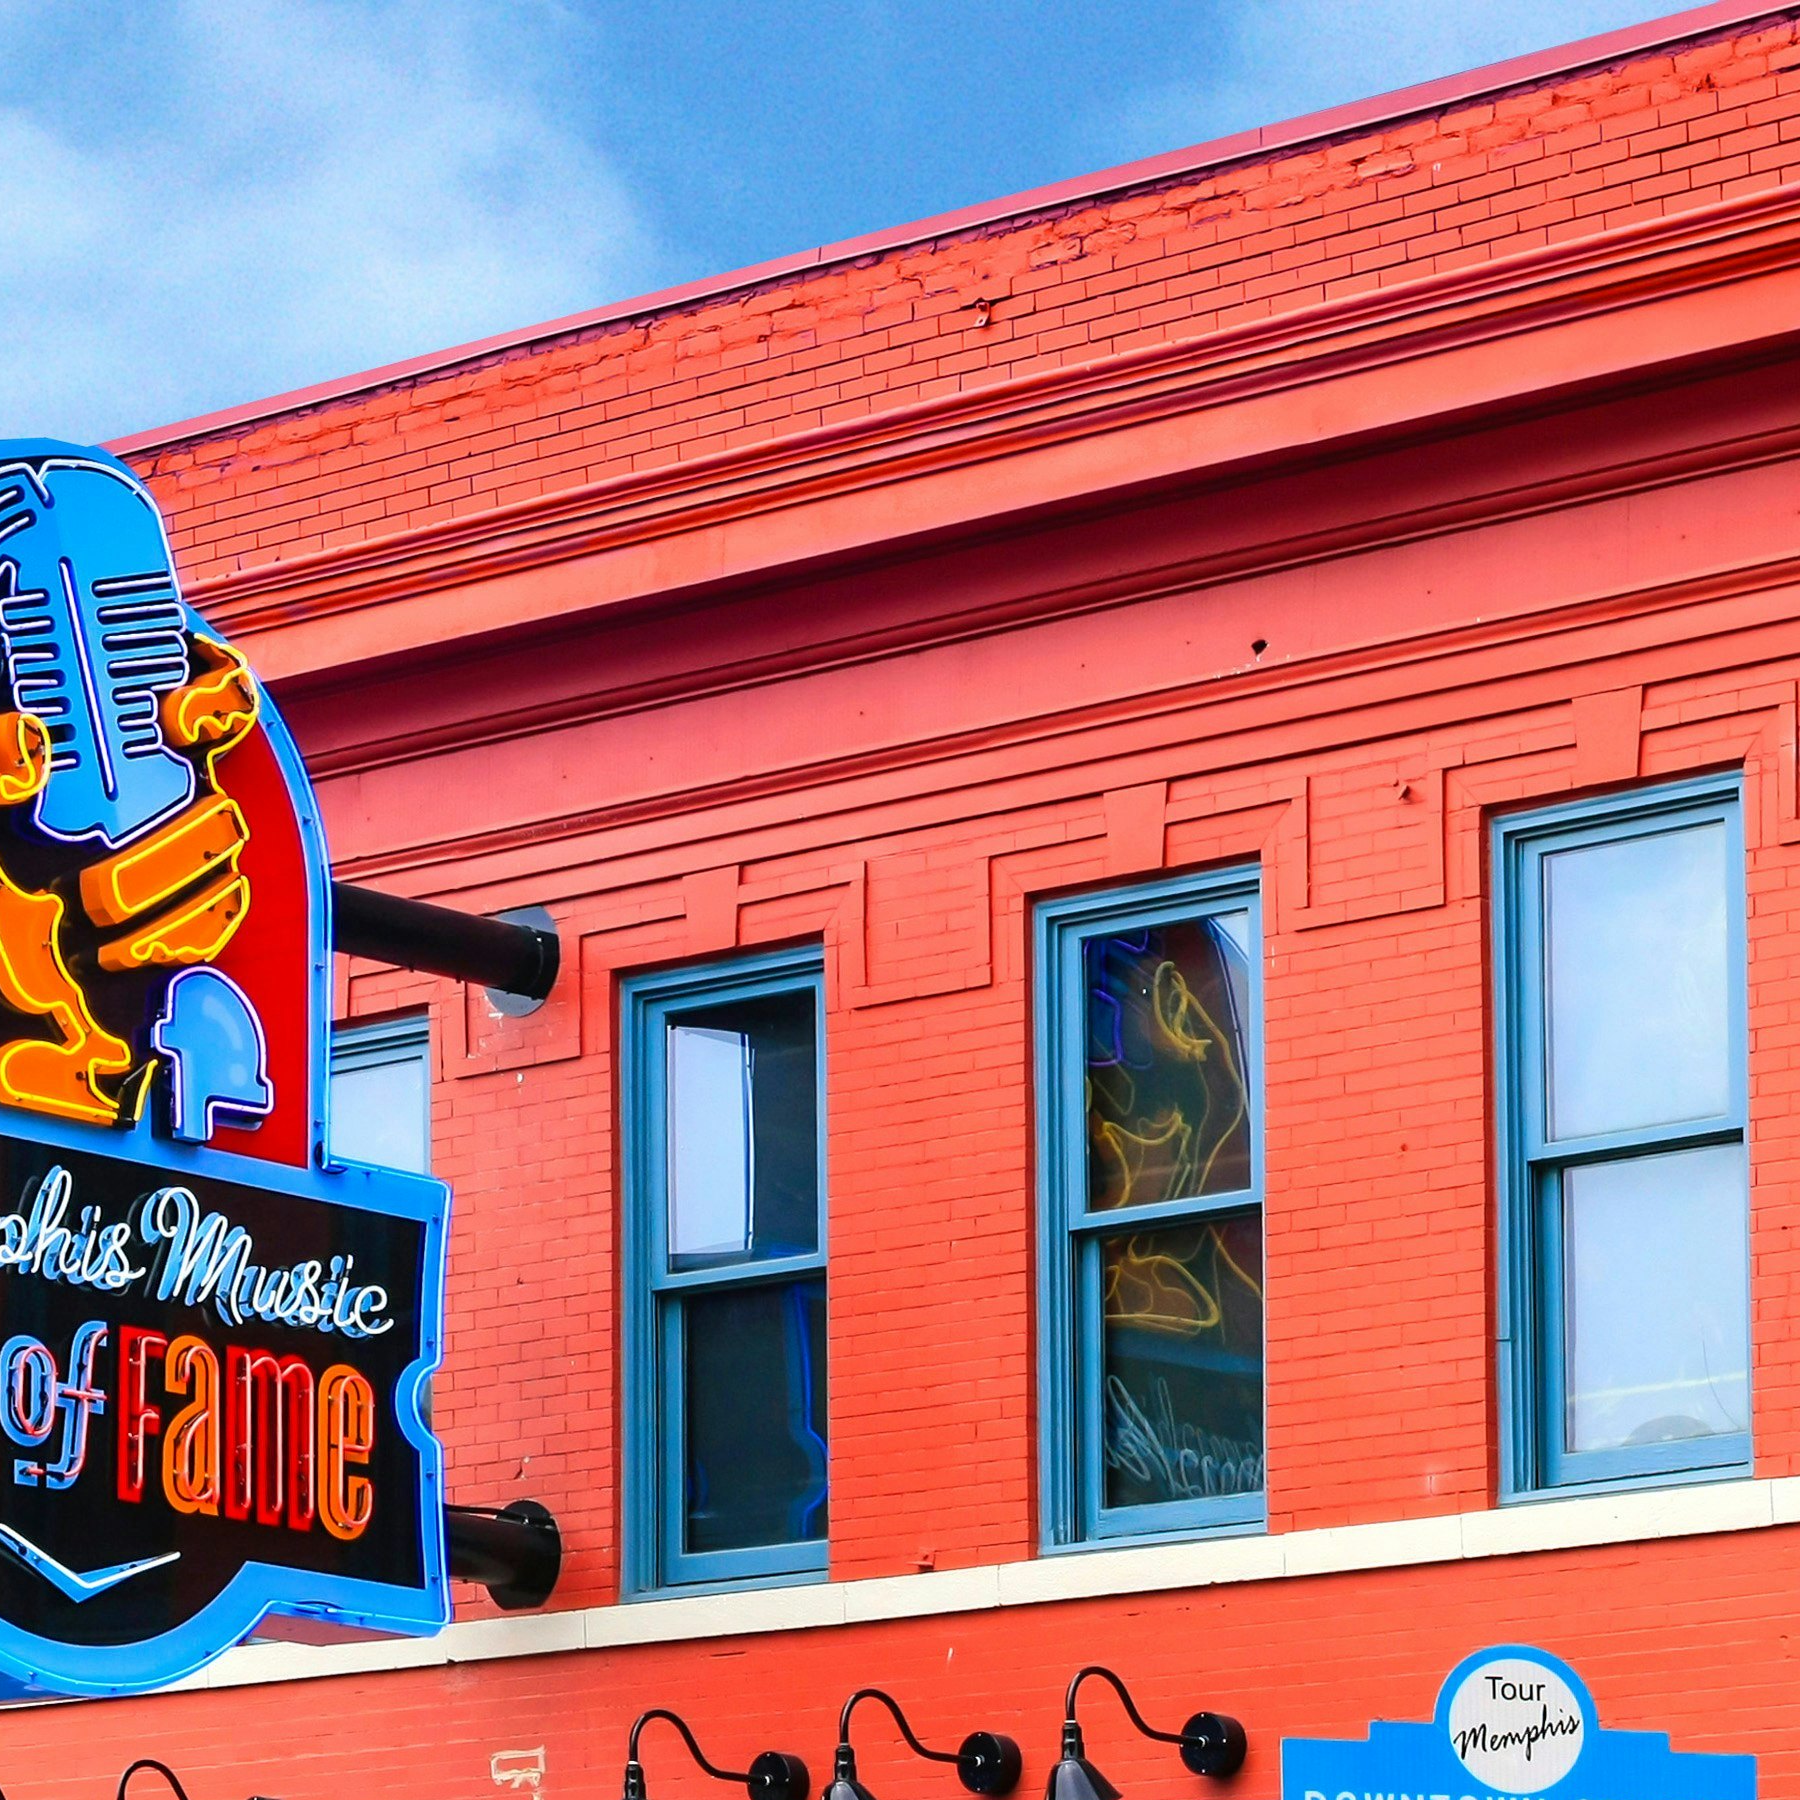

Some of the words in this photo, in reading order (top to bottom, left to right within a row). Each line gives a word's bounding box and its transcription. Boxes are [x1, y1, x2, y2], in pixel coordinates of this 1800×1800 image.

[143, 1187, 393, 1334] Music
[0, 1321, 108, 1488] of
[1453, 1705, 1580, 1761] Memphis
[1485, 1676, 1546, 1703] Tour
